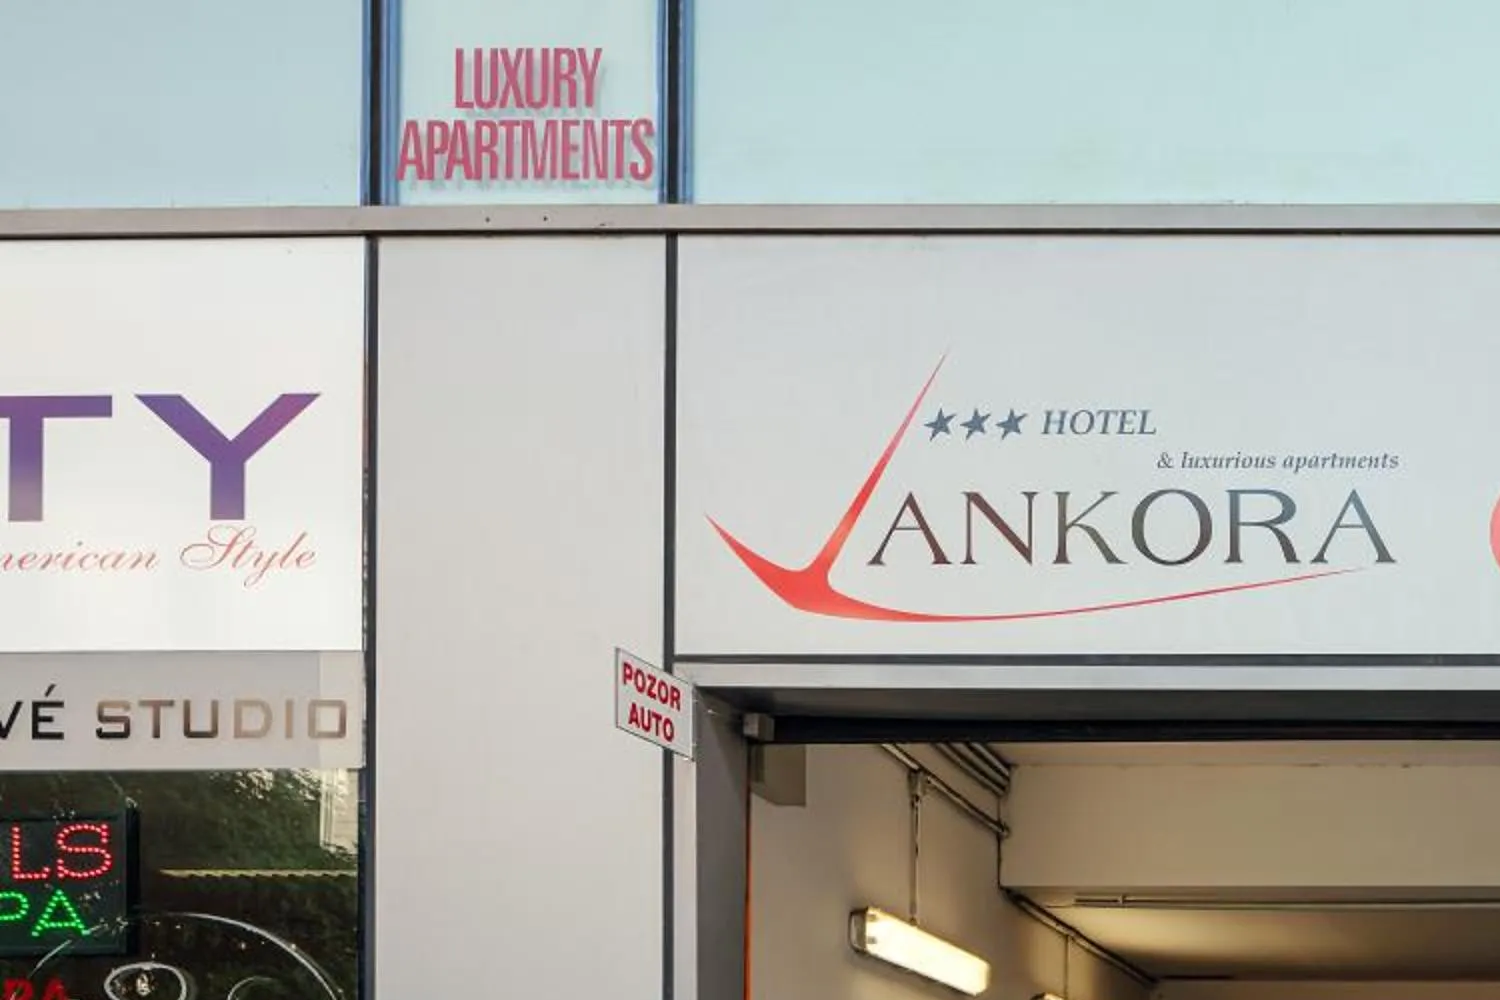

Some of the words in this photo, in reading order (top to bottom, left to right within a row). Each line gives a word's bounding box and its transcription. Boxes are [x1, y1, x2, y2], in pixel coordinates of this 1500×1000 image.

[455, 47, 603, 110] LUXURY
[396, 118, 655, 181] APARTMENTS
[1042, 409, 1157, 437] HOTEL
[0, 393, 321, 522] TY
[1156, 451, 1175, 470] &
[1180, 451, 1277, 470] luxurious
[1282, 452, 1400, 474] apartments
[179, 524, 317, 588] Style
[866, 488, 1397, 567] ANKORA
[622, 660, 681, 713] POZOR
[95, 699, 347, 740] STUDIO
[628, 701, 675, 742] AUTO
[10, 823, 113, 880] LS
